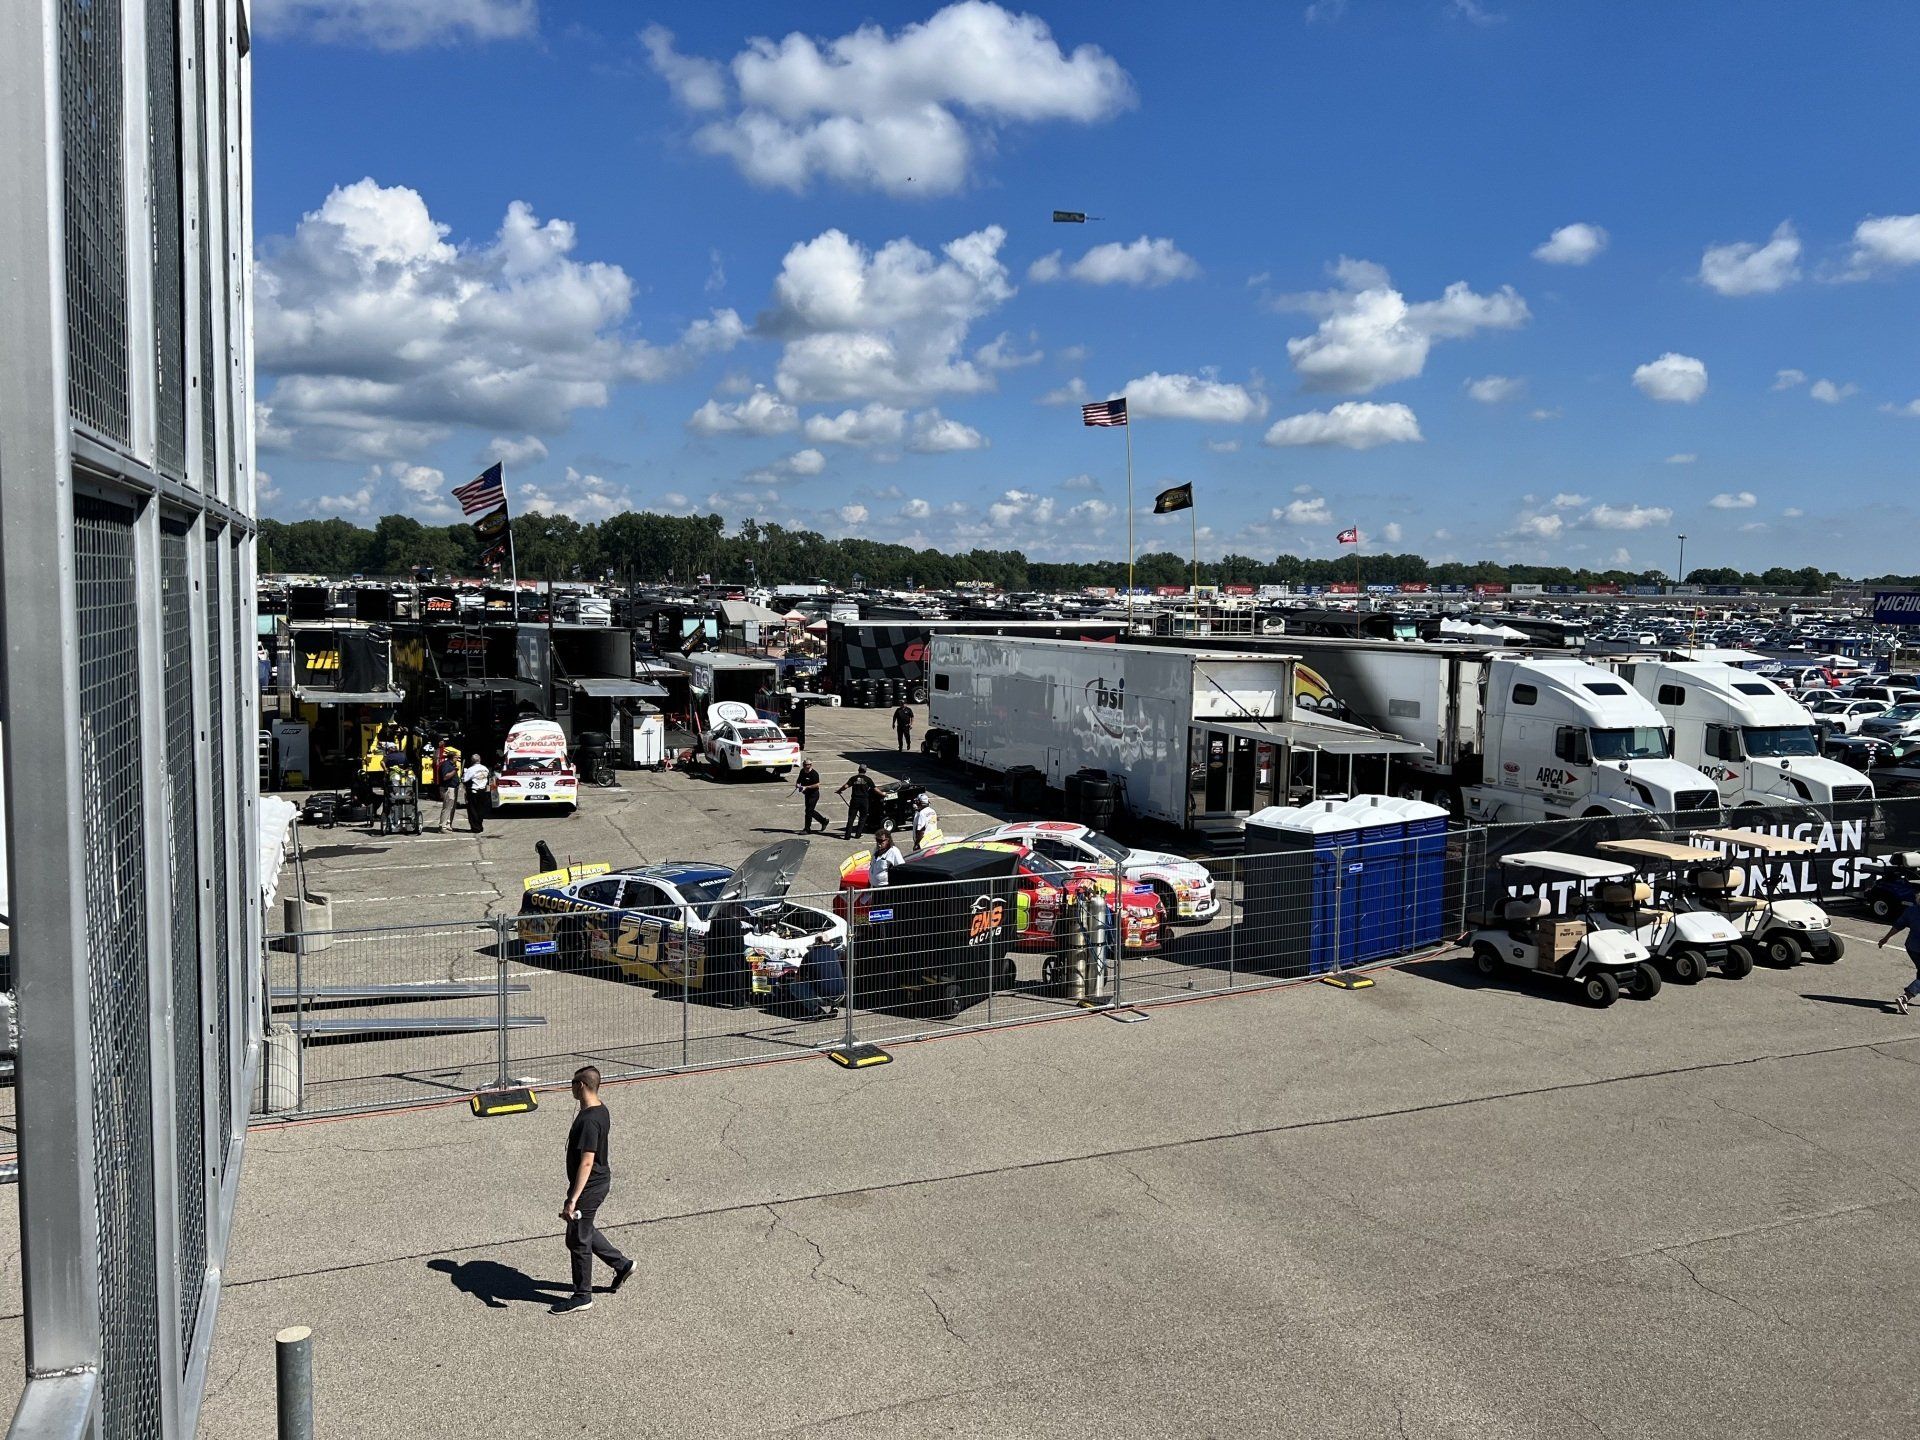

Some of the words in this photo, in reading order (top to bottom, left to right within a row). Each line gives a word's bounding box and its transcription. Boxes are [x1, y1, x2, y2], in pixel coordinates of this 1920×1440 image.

[1095, 677, 1125, 710] bsi
[528, 781, 546, 789] 988
[1536, 766, 1564, 785] ARCA
[1688, 819, 1863, 863] MICHIGAN
[532, 893, 573, 914] GOLDEN
[970, 906, 1004, 937] GMS
[616, 915, 663, 963] 23
